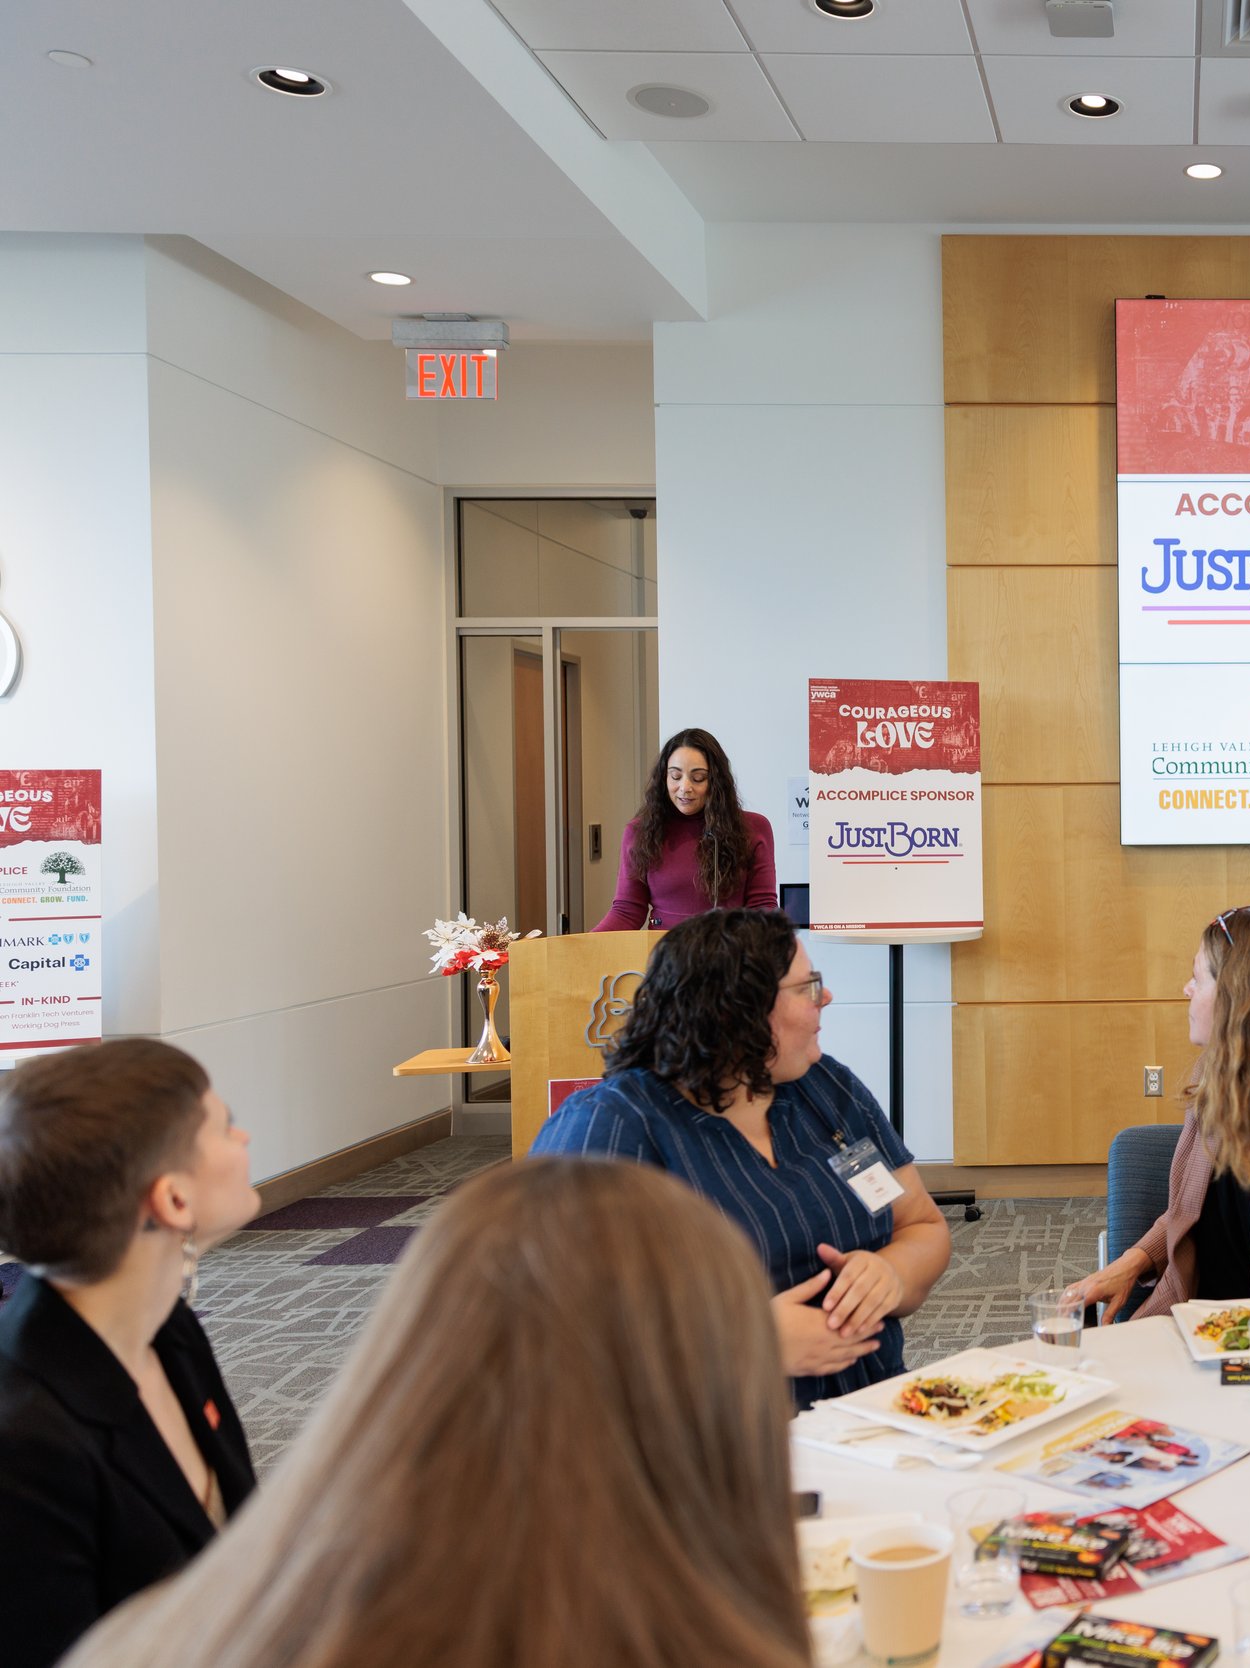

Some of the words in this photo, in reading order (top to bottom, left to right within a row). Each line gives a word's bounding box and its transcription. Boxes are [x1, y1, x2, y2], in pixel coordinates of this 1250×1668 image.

[418, 354, 488, 398] EXIT
[810, 691, 837, 700] ywca
[839, 704, 952, 719] COURAGEOUS
[856, 721, 935, 749] LOVE
[1152, 742, 1213, 752] LEHIGH
[816, 790, 907, 801] ACCOMPLICE
[910, 790, 975, 801] SPONSOR
[48, 884, 91, 892] Foundation
[67, 895, 88, 903] FUND.
[8, 956, 65, 971] Capital
[21, 995, 71, 1005] IN-KIND
[12, 1011, 40, 1019] Franklin
[12, 1022, 42, 1030] Working
[44, 1021, 59, 1029] Dog
